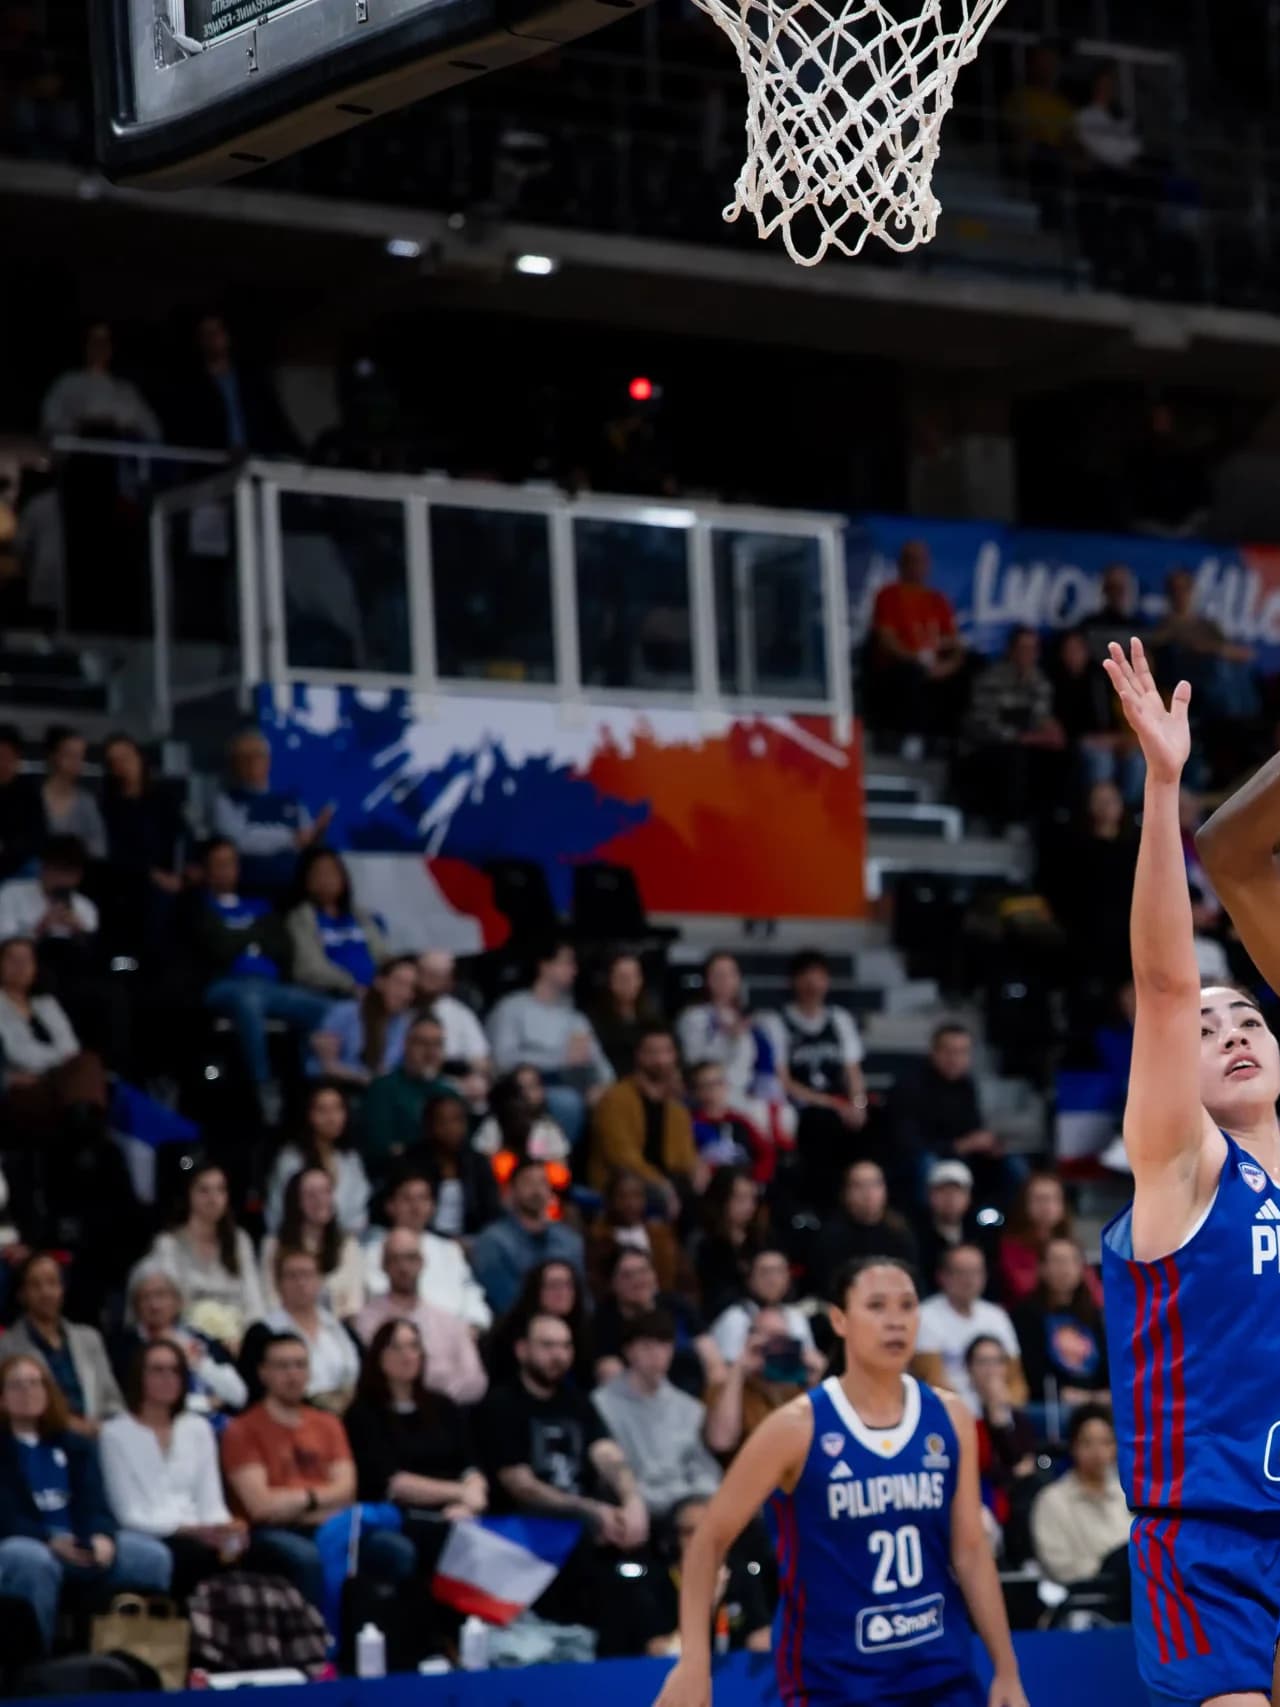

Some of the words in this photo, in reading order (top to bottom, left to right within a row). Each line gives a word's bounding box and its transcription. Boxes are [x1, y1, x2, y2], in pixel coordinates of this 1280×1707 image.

[827, 1473, 945, 1520] PILIPINAS
[868, 1525, 924, 1595] 20
[892, 1607, 938, 1637] Smart
